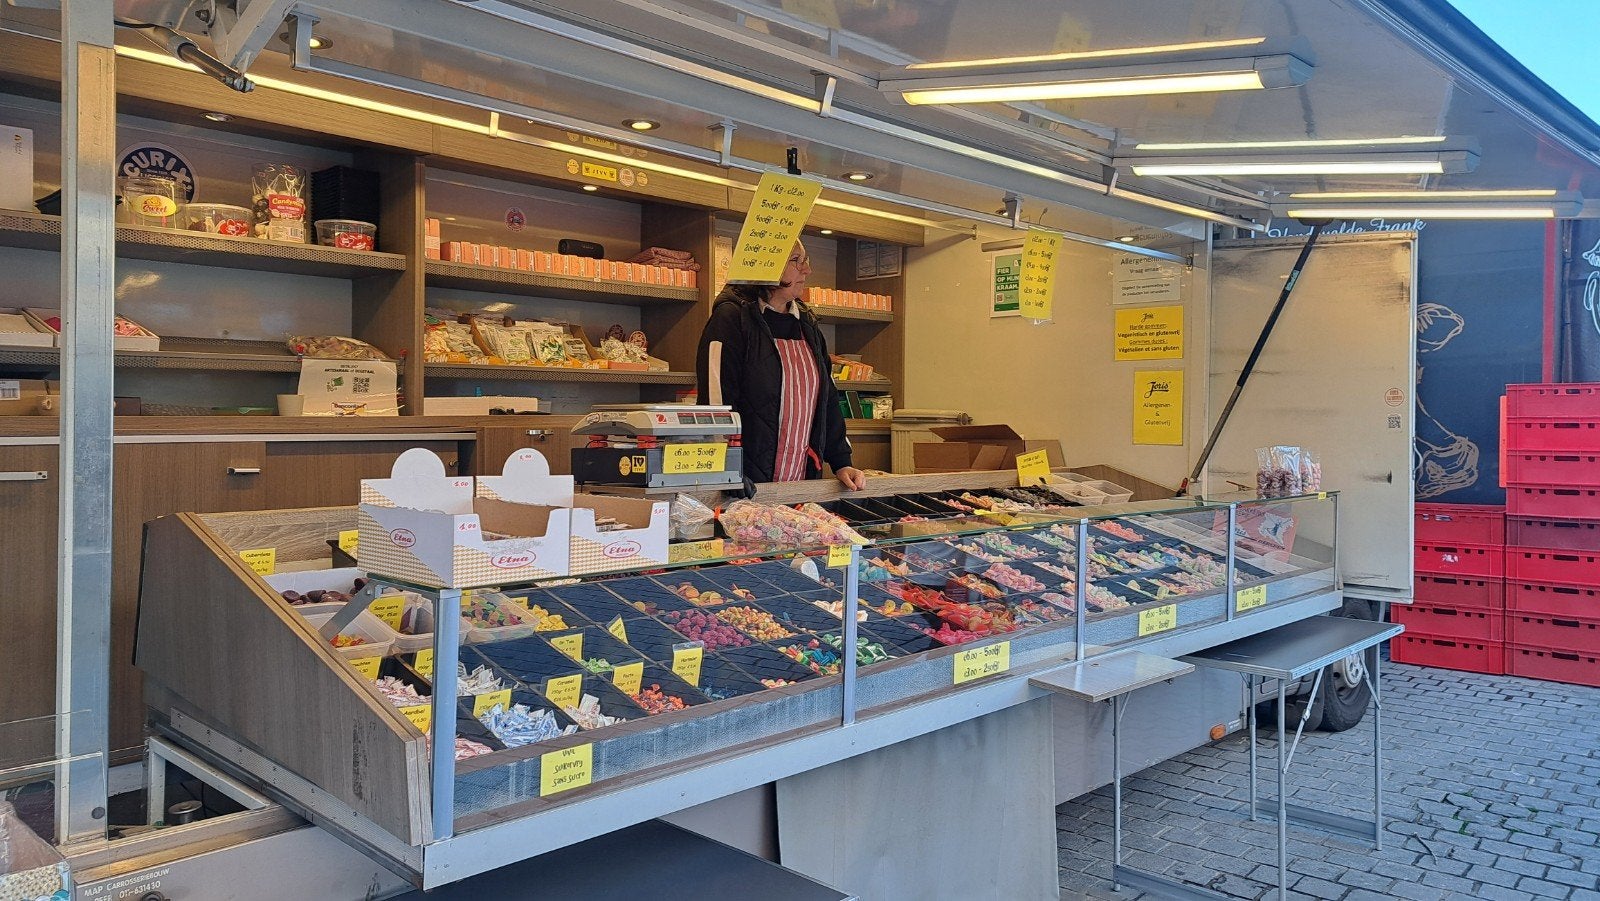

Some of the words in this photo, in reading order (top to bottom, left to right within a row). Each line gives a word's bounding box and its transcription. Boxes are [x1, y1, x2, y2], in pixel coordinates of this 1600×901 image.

[394, 533, 412, 542] Etna
[609, 546, 634, 554] Etna
[498, 556, 529, 564] Etna
[84, 886, 103, 896] MAP
[119, 881, 160, 898] 011-631430
